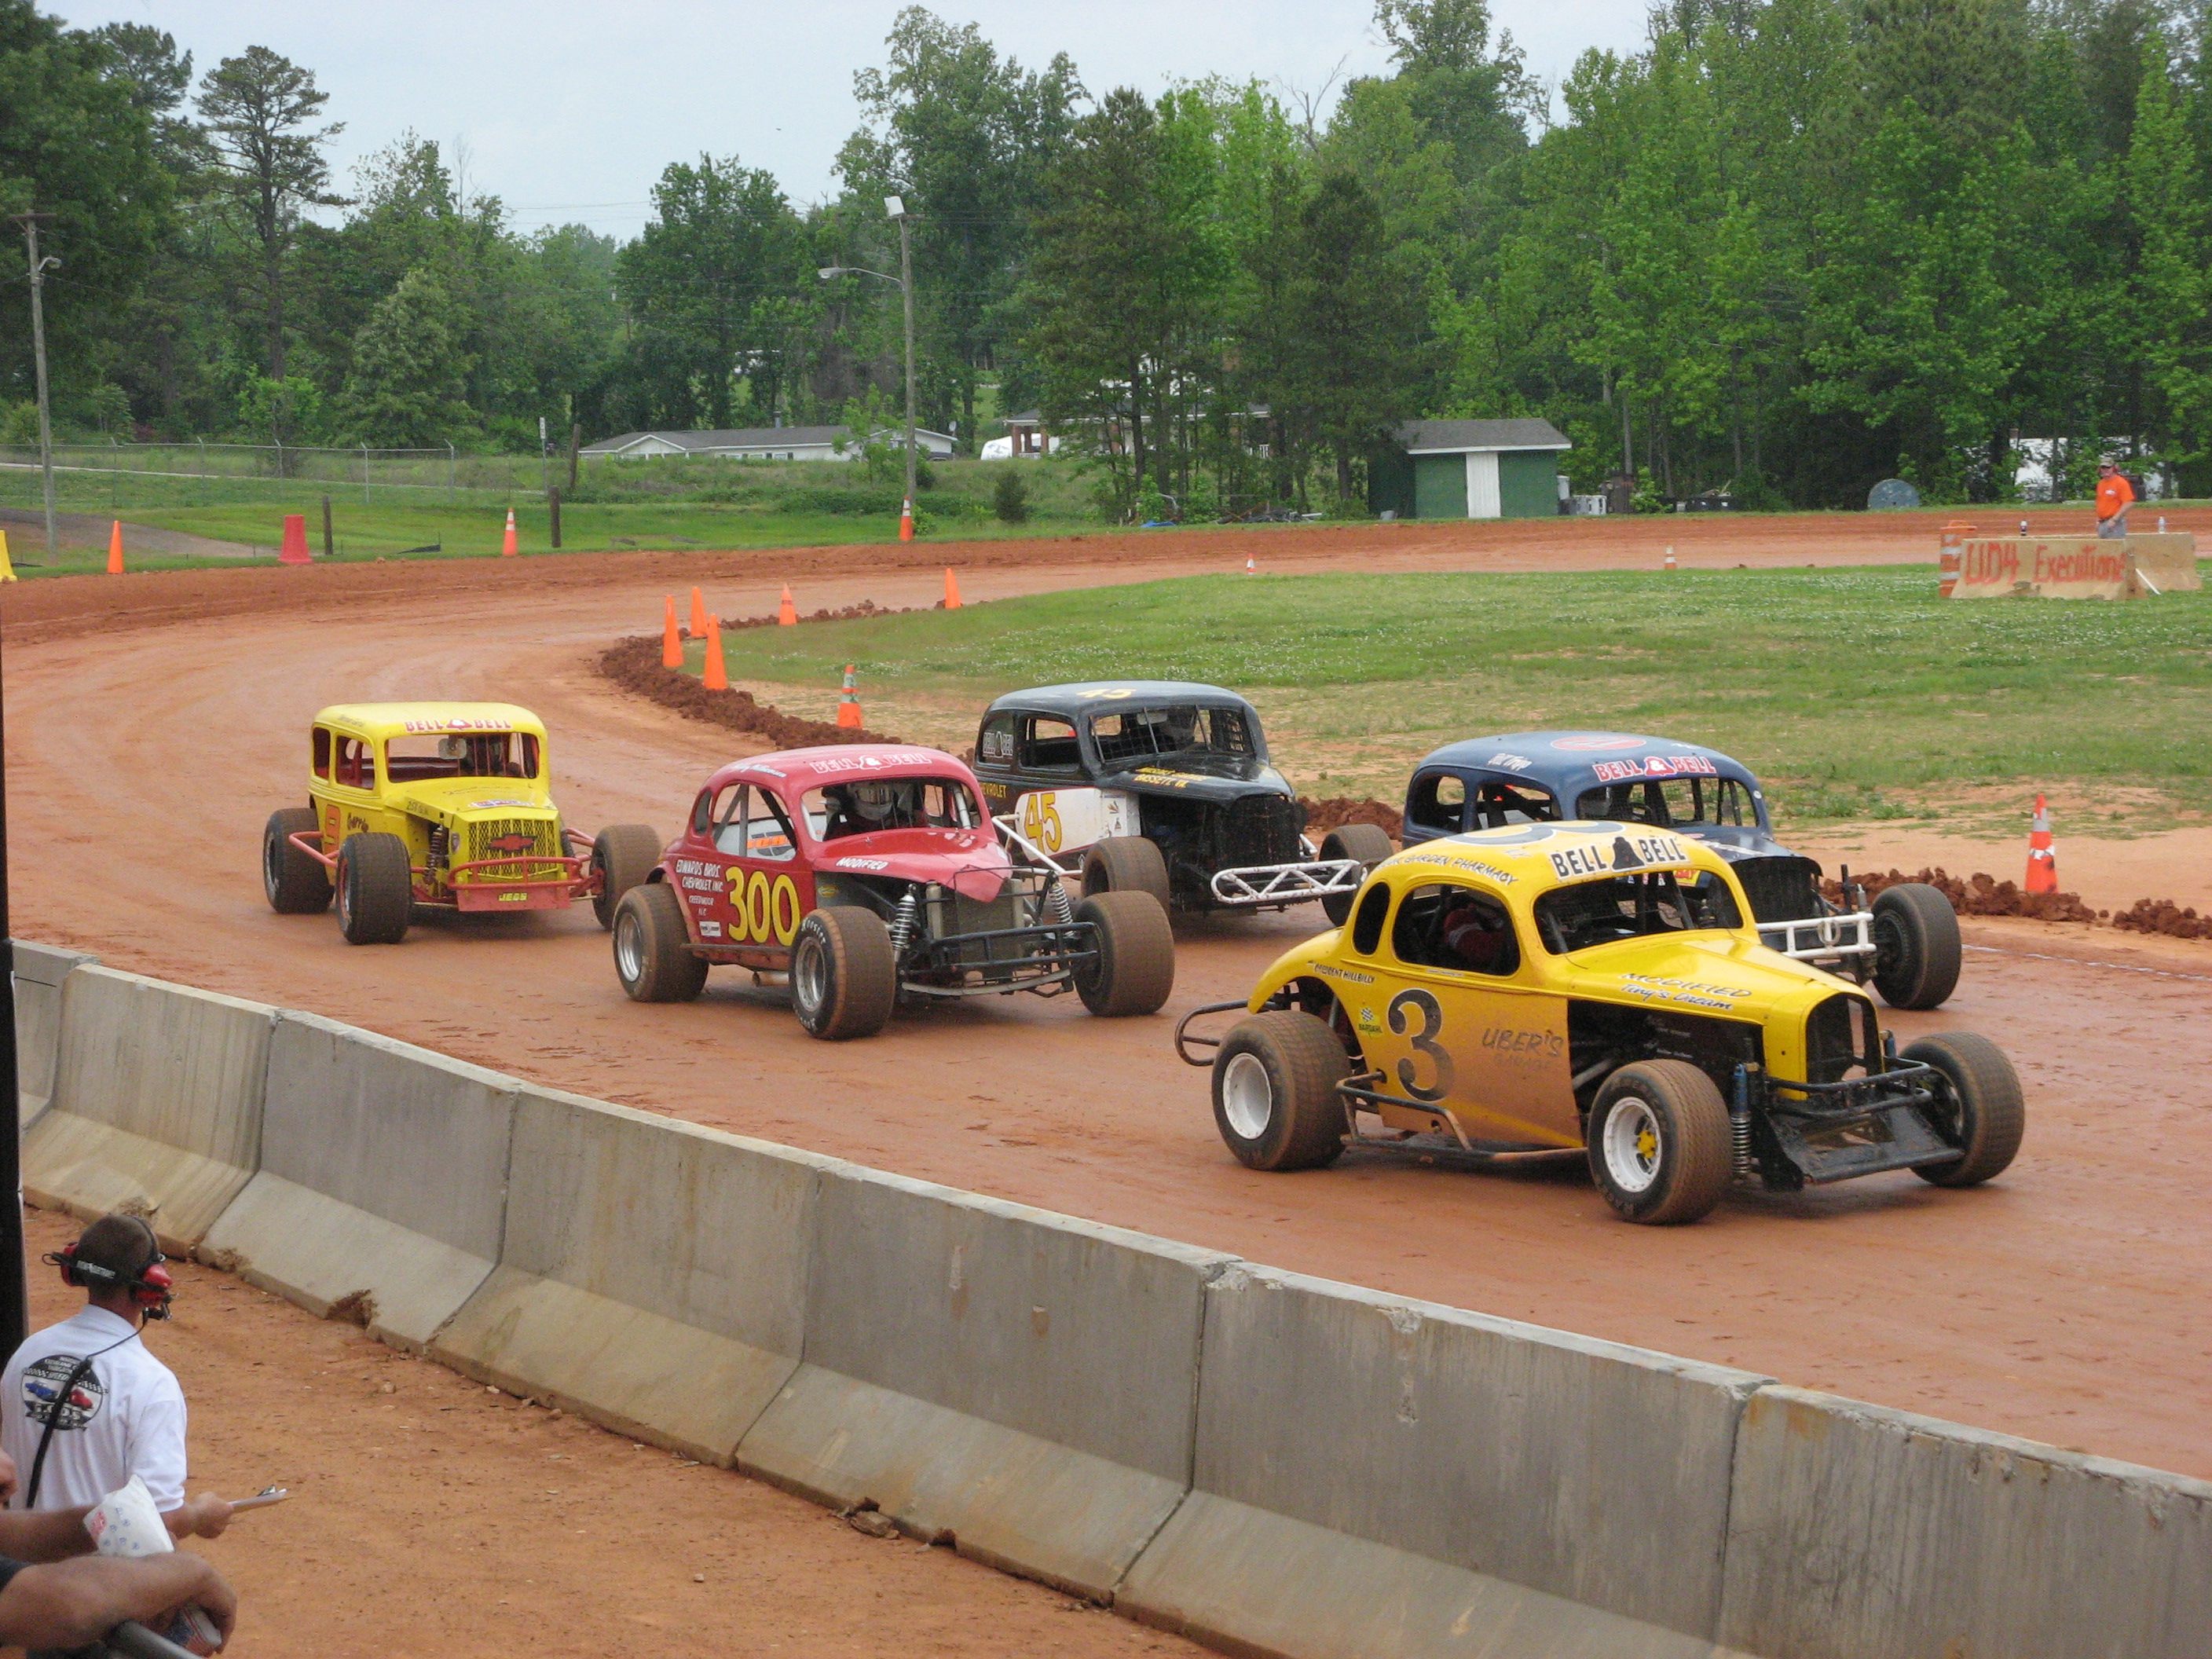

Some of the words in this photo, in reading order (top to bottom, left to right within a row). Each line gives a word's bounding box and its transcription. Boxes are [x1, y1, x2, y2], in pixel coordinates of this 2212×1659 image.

[404, 720, 444, 731] BELL
[474, 720, 511, 729] BELL
[810, 758, 859, 774] BELL
[884, 753, 932, 766] BELL
[1592, 759, 1643, 782] BELL
[1668, 756, 1716, 774] BELL
[1024, 792, 1063, 854] 45
[835, 858, 889, 870] MODIFIED
[1404, 854, 1452, 866] GARDEN
[1452, 857, 1518, 887] PHARMACY
[1551, 845, 1607, 878] BELL
[1639, 837, 1687, 862] BELL
[726, 866, 800, 947] 300
[1618, 973, 1752, 998] MODIFIED
[1621, 983, 1671, 1002] Tiny's
[1673, 992, 1733, 1010] Dream
[1388, 988, 1453, 1102] 3
